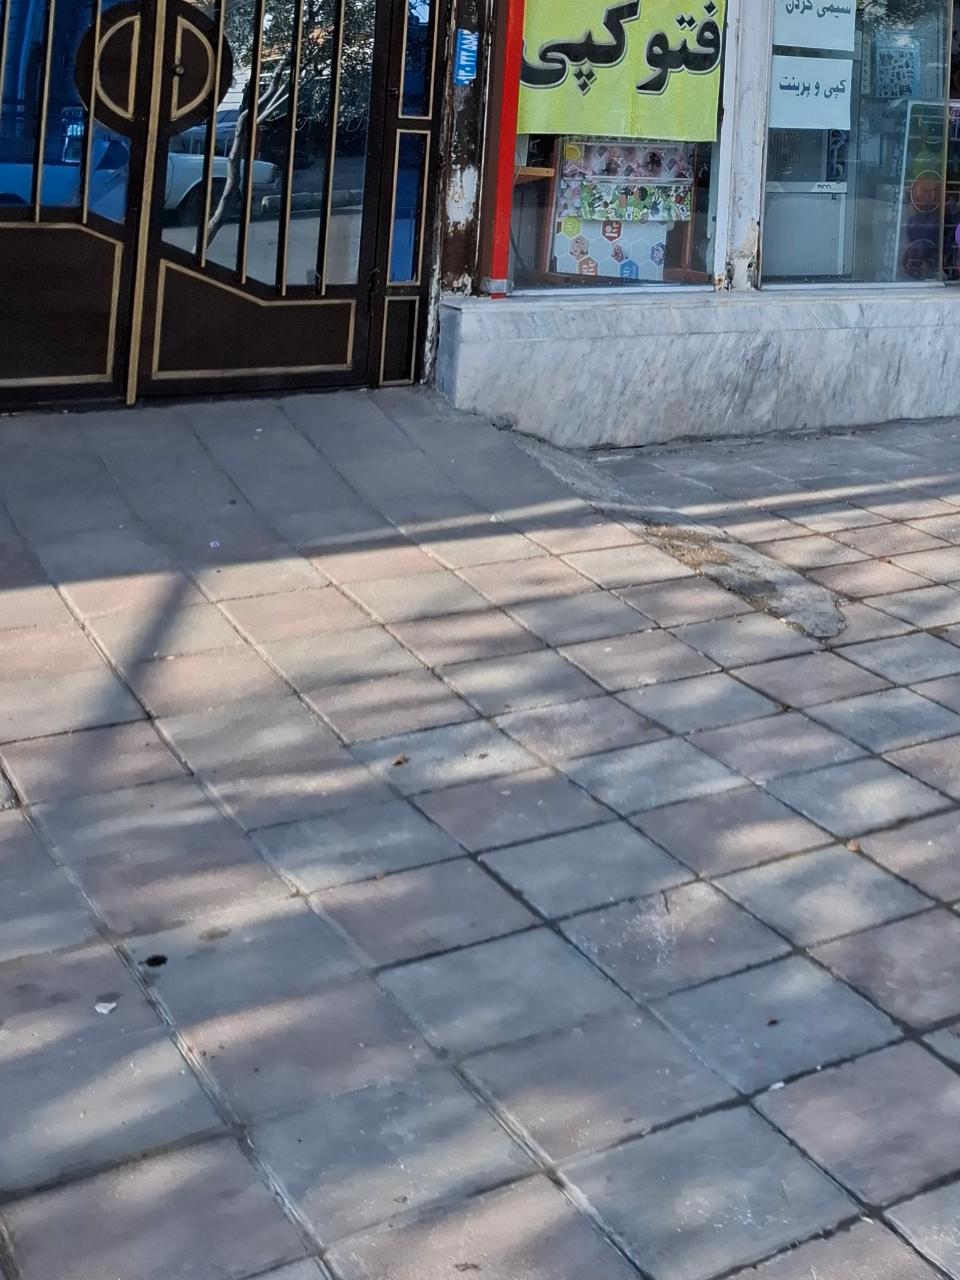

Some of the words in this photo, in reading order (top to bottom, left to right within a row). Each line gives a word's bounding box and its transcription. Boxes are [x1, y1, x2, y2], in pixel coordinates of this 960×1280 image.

[816, 3, 851, 19] سیمی
[779, 75, 811, 98] پرینت
[814, 81, 821, 97] و
[823, 79, 847, 99] کپی
